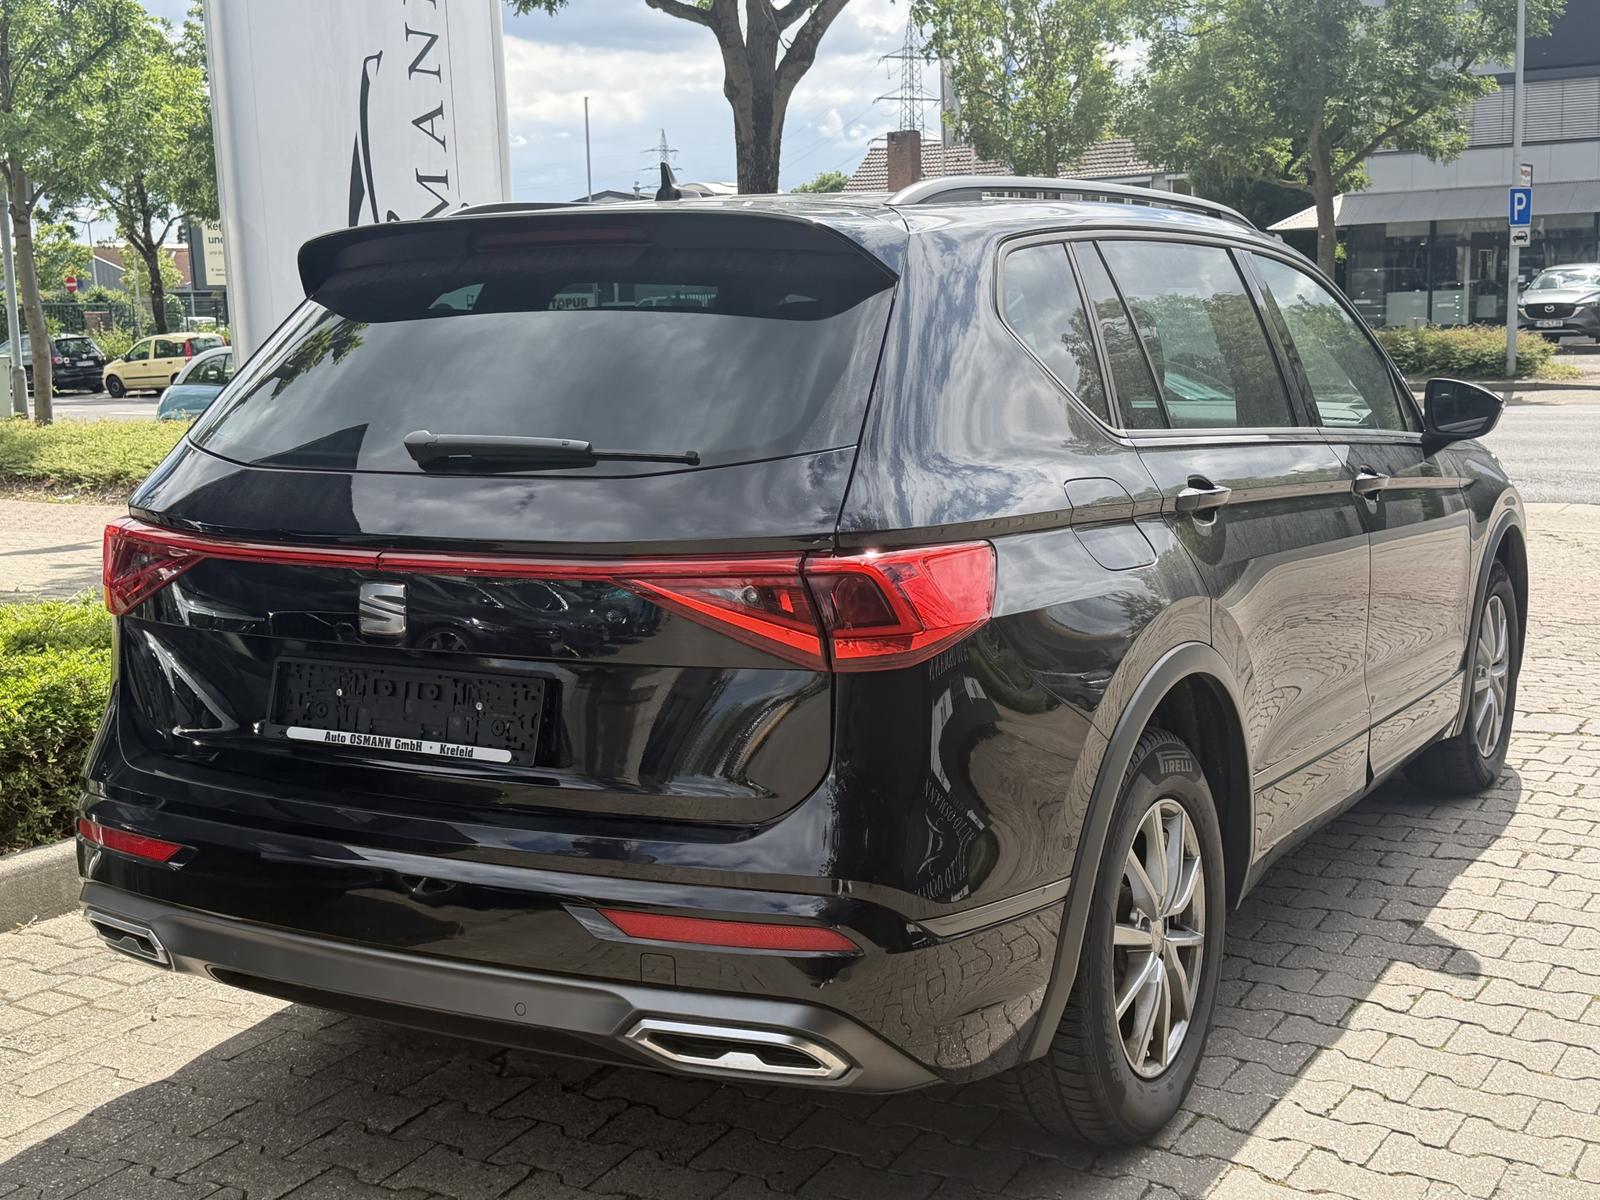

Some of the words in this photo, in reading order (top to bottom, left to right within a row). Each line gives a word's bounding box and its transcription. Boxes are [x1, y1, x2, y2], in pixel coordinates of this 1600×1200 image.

[402, 0, 449, 218] MAN
[1514, 192, 1527, 221] P
[324, 731, 347, 743] Auto
[350, 733, 392, 749] OSMANN
[394, 738, 423, 752] GmbH
[439, 743, 474, 758] Krefeld
[1156, 750, 1193, 774] PIRELLI
